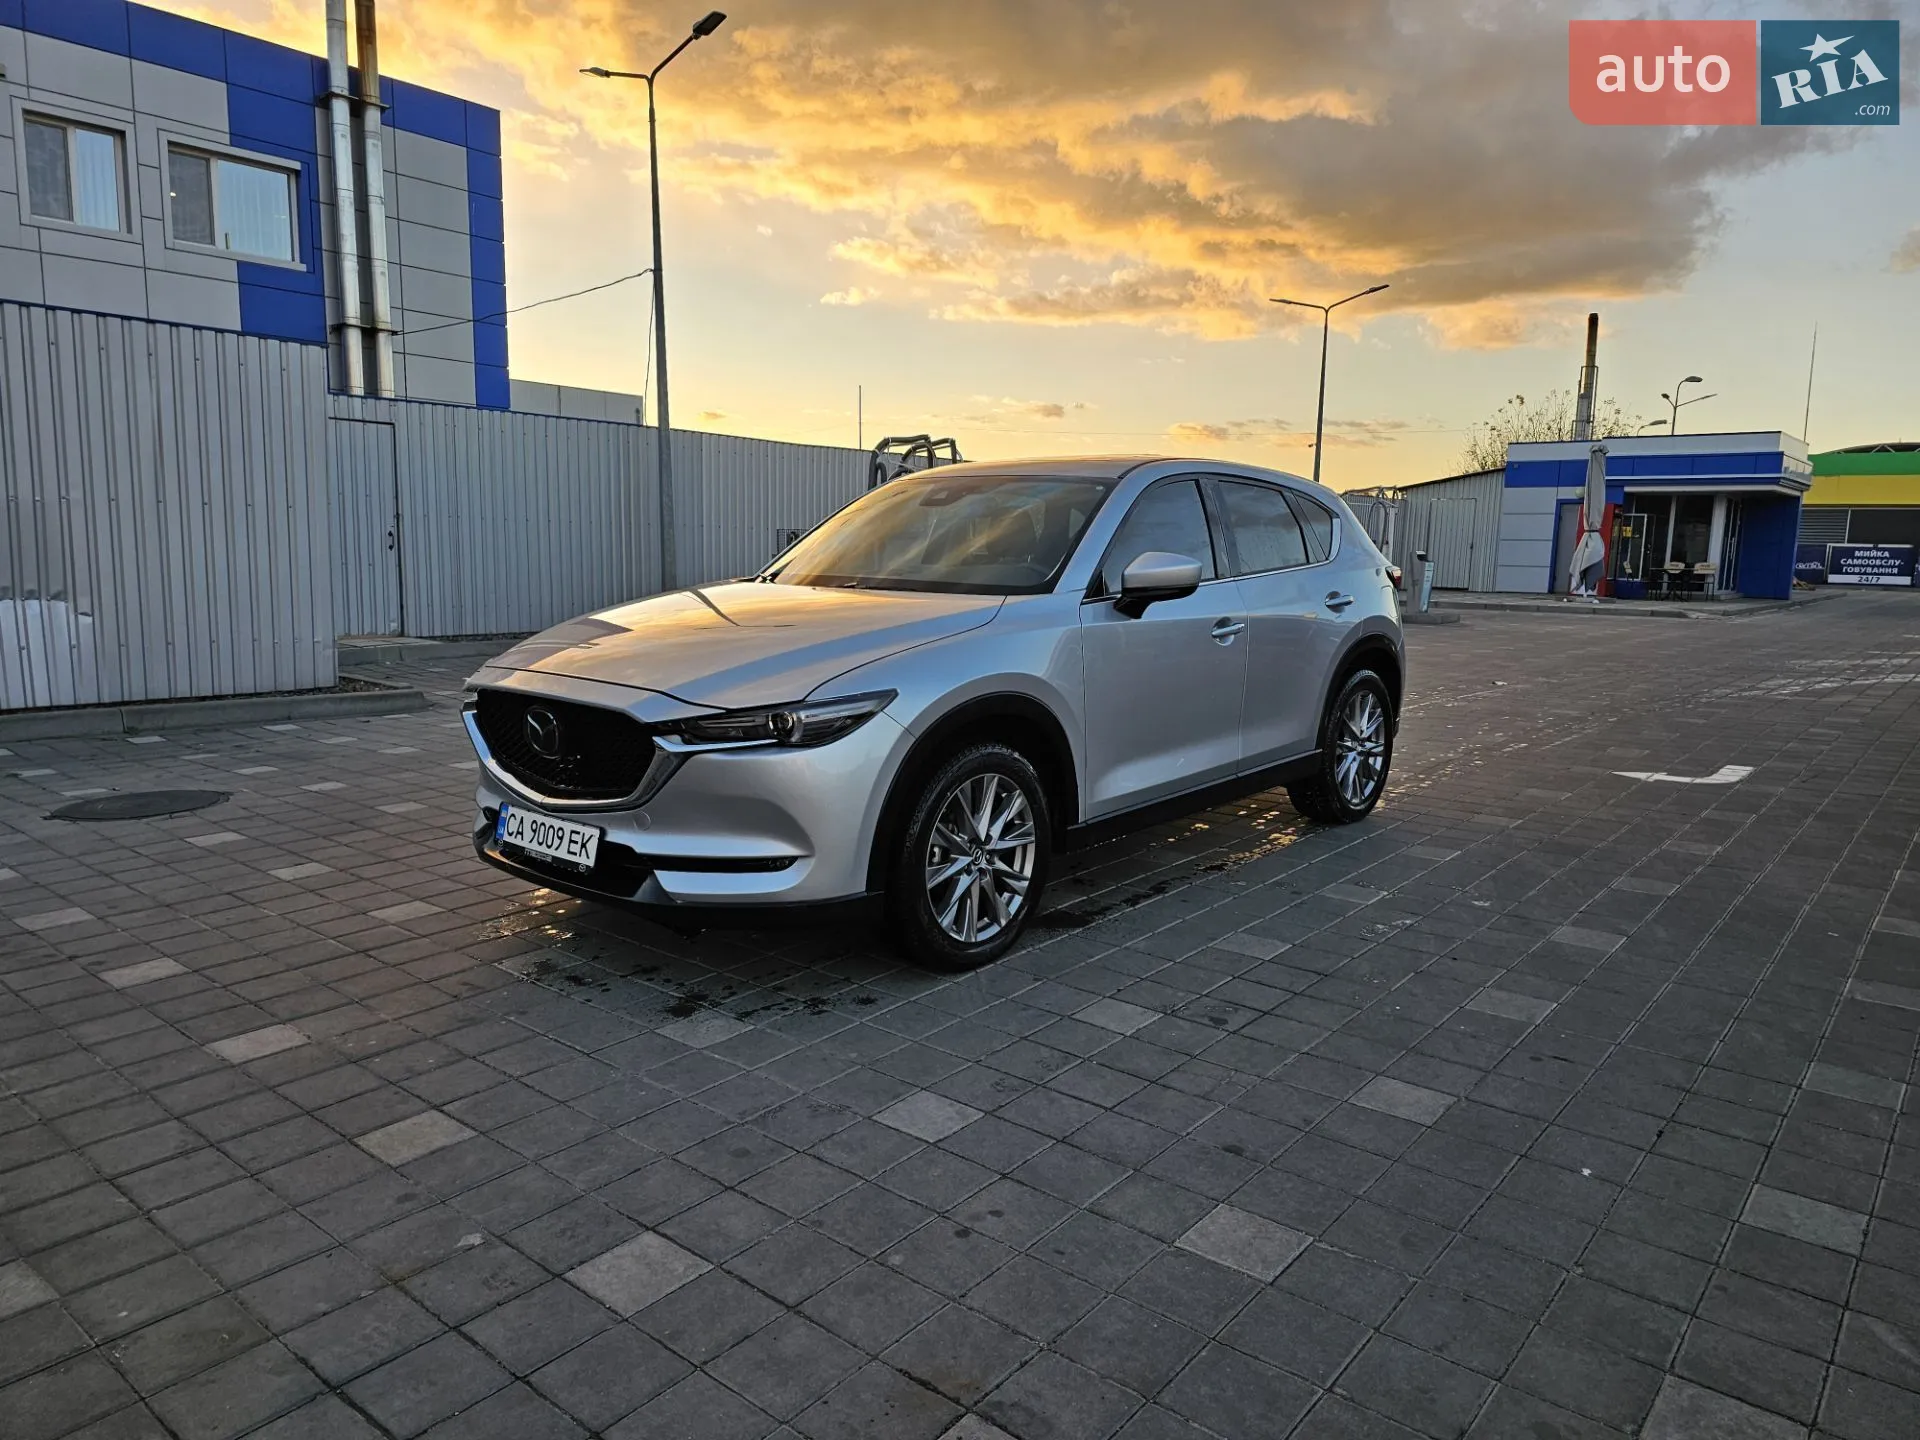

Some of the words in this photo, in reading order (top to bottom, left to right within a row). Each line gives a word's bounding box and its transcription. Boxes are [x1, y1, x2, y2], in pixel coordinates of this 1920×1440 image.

[1854, 550, 1890, 558] МИЙКА
[1840, 558, 1905, 566] САМООБСЛУ-
[1842, 566, 1898, 574] ГОВУВАННЯ
[506, 813, 524, 841] CA
[529, 819, 565, 851] 9009
[567, 829, 594, 860] EK
